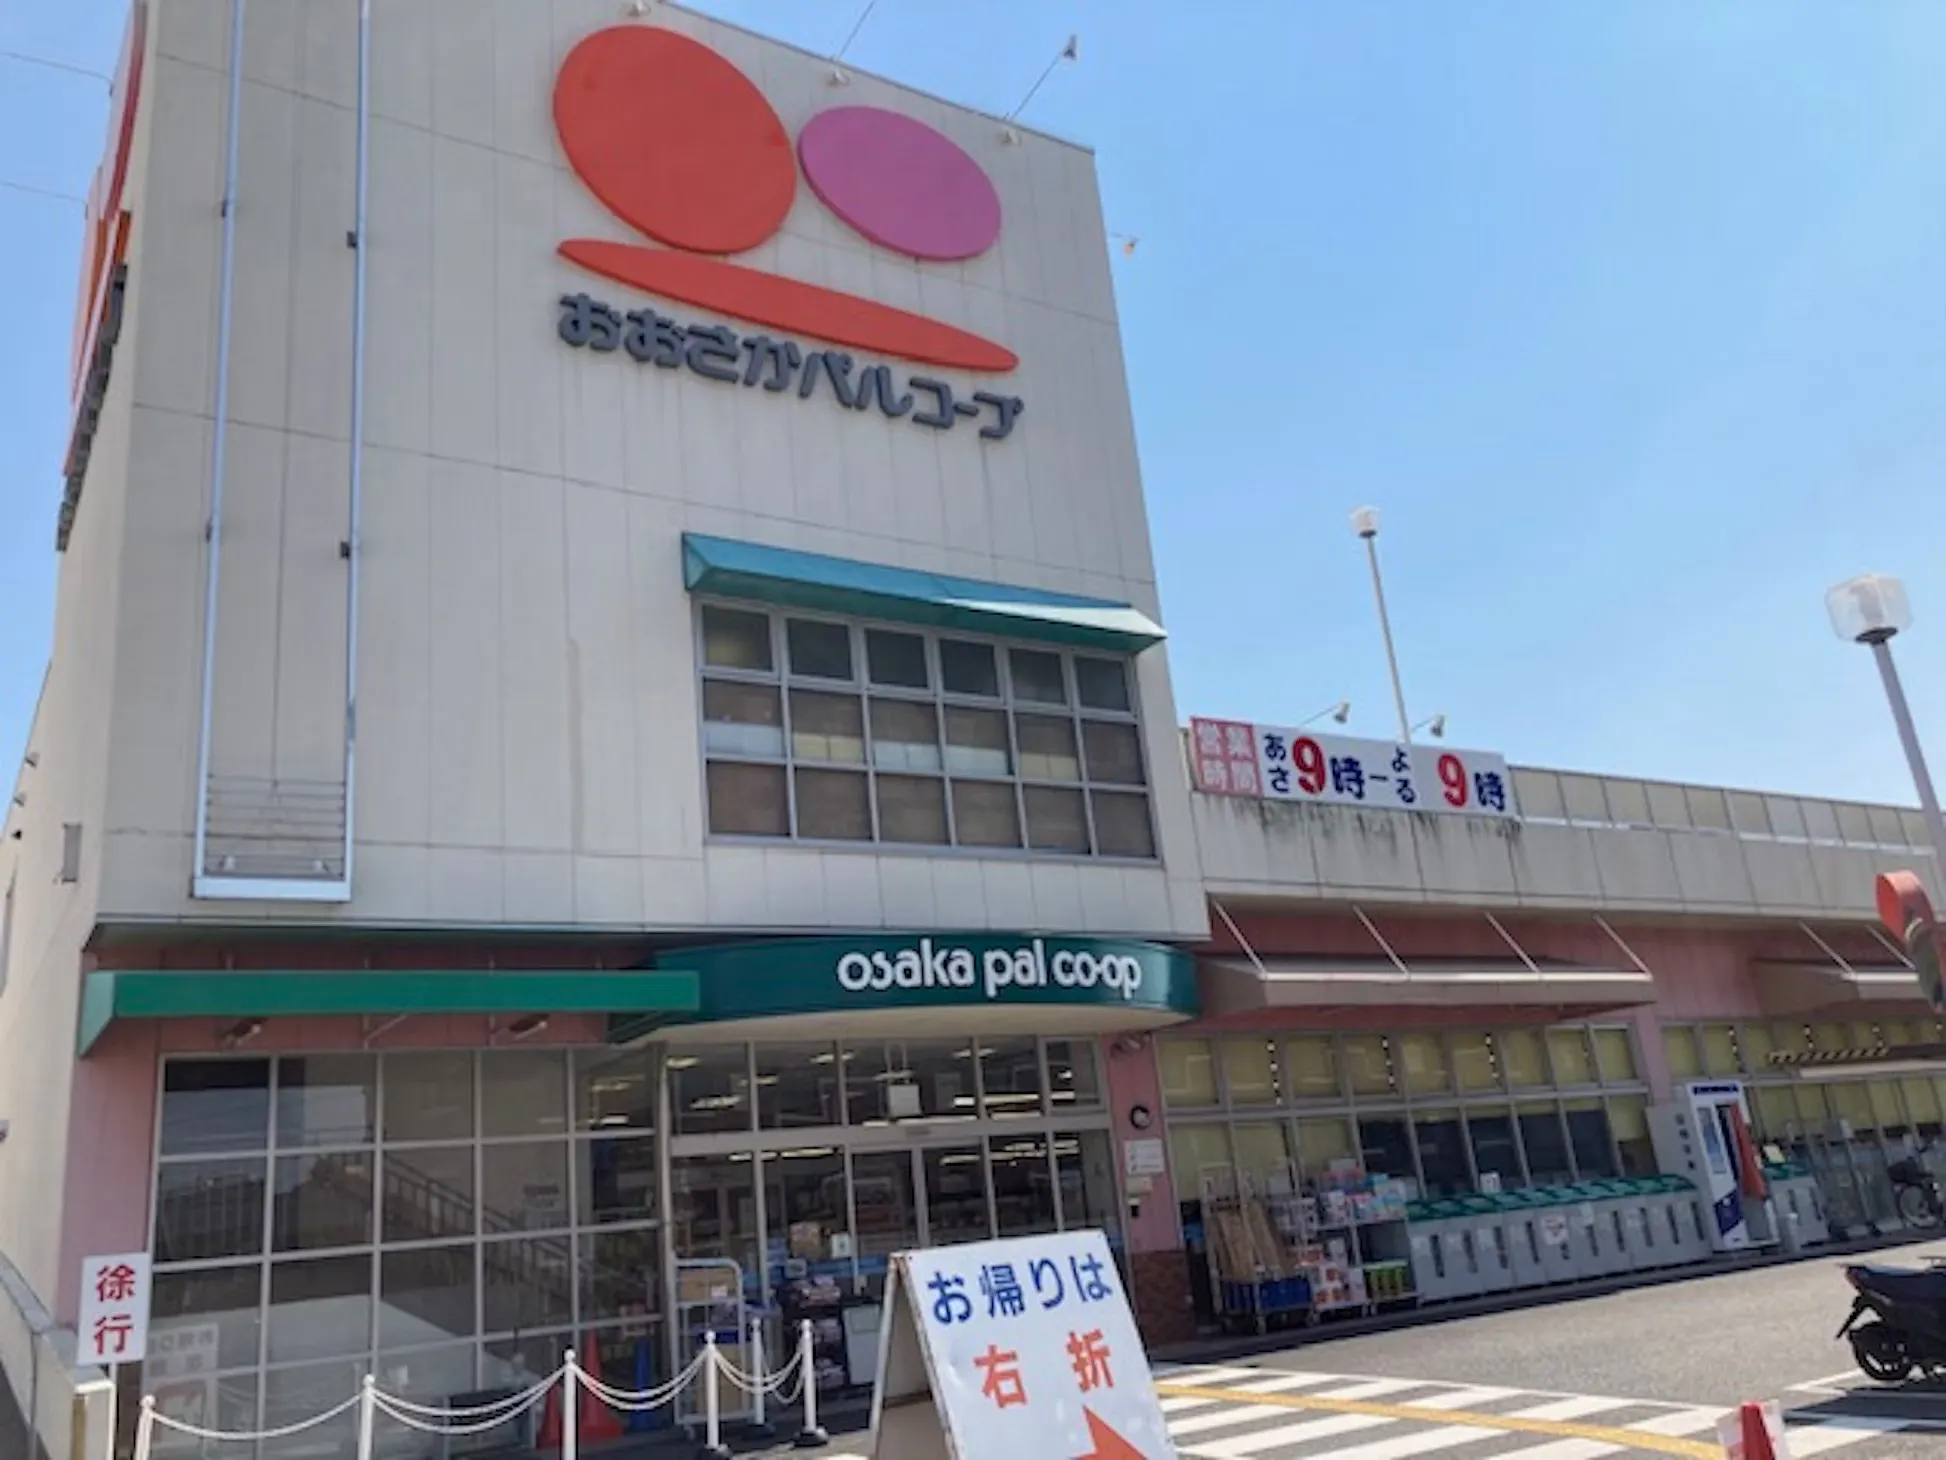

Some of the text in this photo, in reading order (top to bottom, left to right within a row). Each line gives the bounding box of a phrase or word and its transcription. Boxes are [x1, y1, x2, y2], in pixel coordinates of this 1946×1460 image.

[557, 292, 1024, 441] おおさかパルコープ
[836, 937, 976, 991] osaka
[983, 938, 1047, 998] pal
[93, 1263, 136, 1356] 徐行
[926, 1252, 1114, 1324] お帰りは
